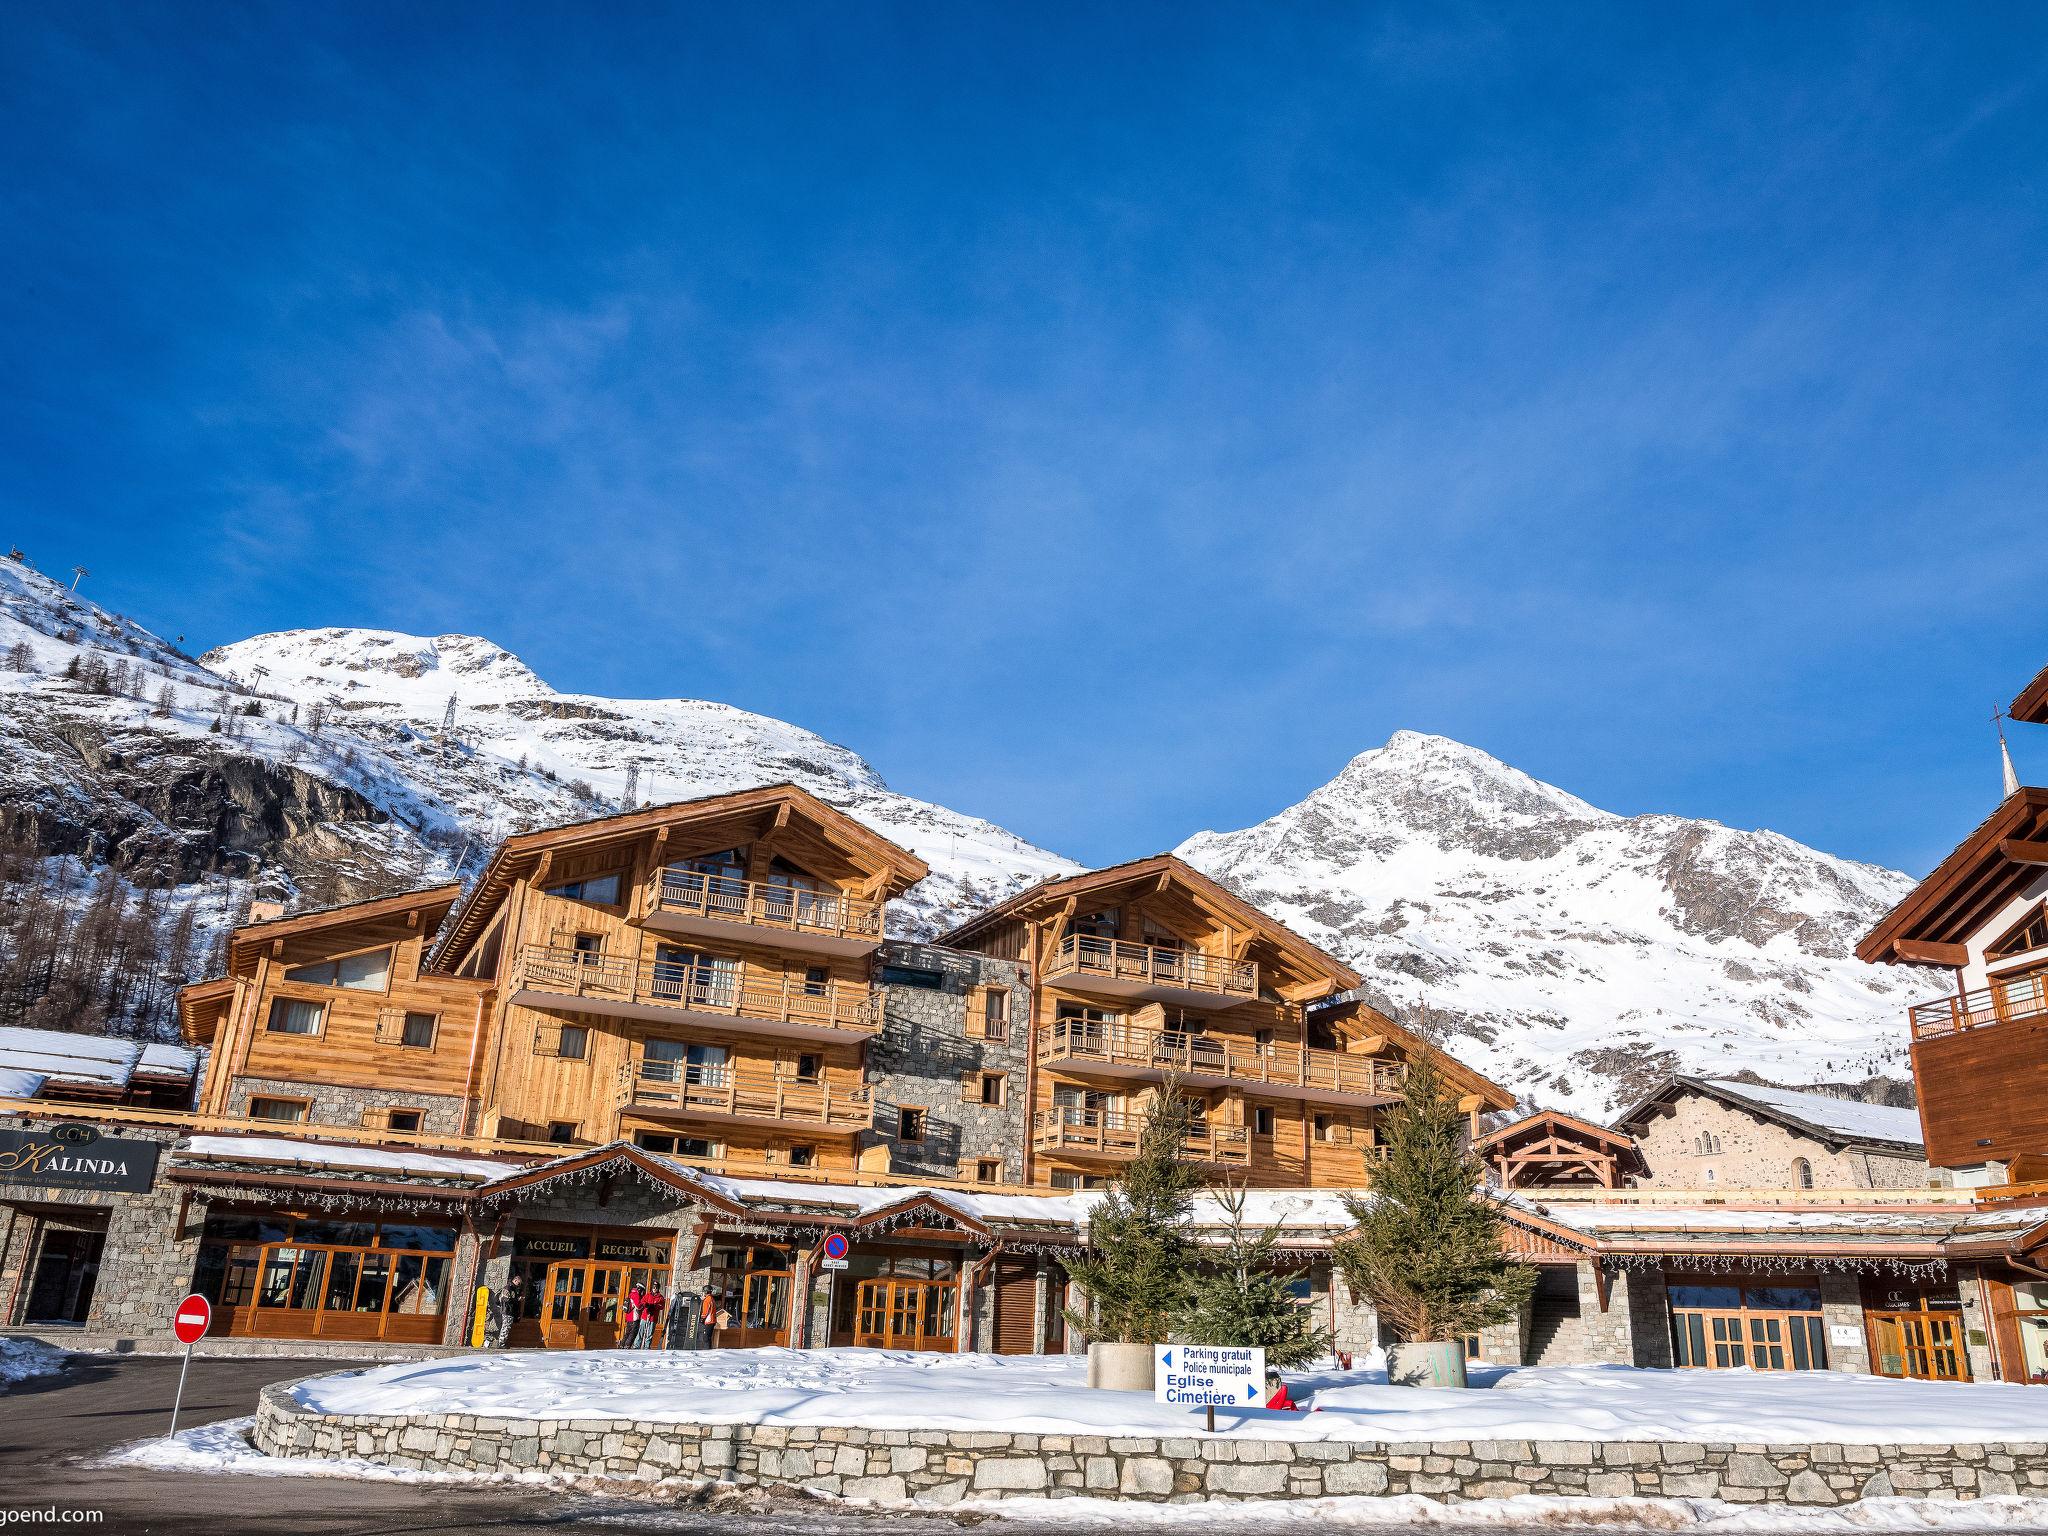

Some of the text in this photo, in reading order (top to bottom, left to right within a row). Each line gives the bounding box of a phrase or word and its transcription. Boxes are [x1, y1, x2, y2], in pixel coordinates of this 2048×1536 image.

[0, 1142, 129, 1176] KALINDA
[526, 1240, 577, 1252] ACCUEIL
[602, 1244, 666, 1258] RECEPTION
[1183, 1347, 1252, 1362] Parking gratuit
[1183, 1361, 1252, 1376] Police municipale
[1167, 1374, 1214, 1388] Eglise
[1166, 1389, 1236, 1405] Cimetière
